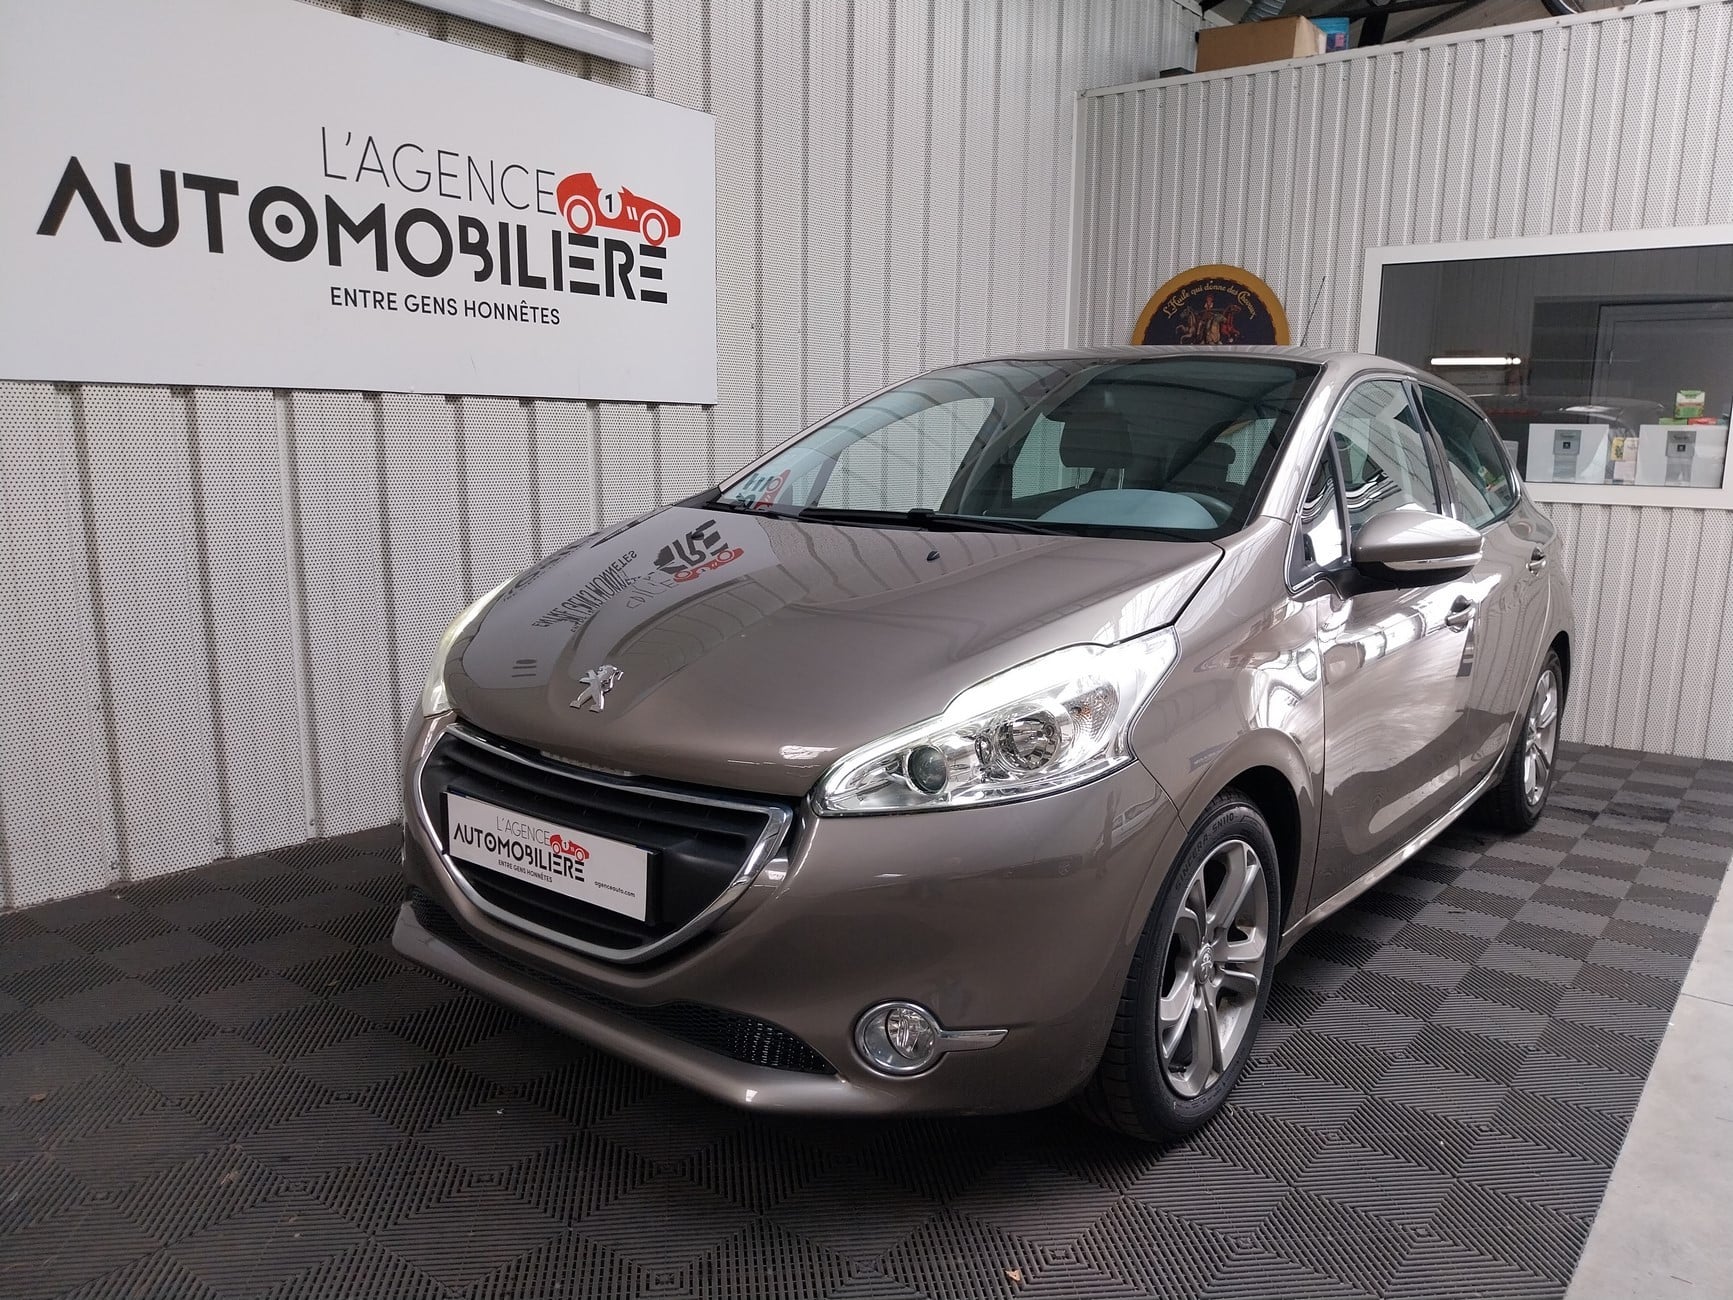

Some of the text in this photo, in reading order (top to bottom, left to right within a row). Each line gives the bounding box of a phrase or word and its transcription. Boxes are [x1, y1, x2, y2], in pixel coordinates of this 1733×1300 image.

[321, 126, 557, 216] L'AGENCE
[604, 193, 614, 213] 1
[36, 156, 668, 305] AUTOMOBILIERE
[330, 286, 561, 326] ENTRE GENS HONNÊTES
[1190, 284, 1203, 296] qui
[1204, 283, 1226, 291] donne
[1226, 285, 1239, 297] des
[496, 815, 551, 847] L'AGENCE
[453, 822, 585, 883] AUTOMOBILIERE
[498, 858, 513, 870] ENTRE
[513, 864, 526, 875] GENS
[594, 880, 636, 898] agenceauto.com
